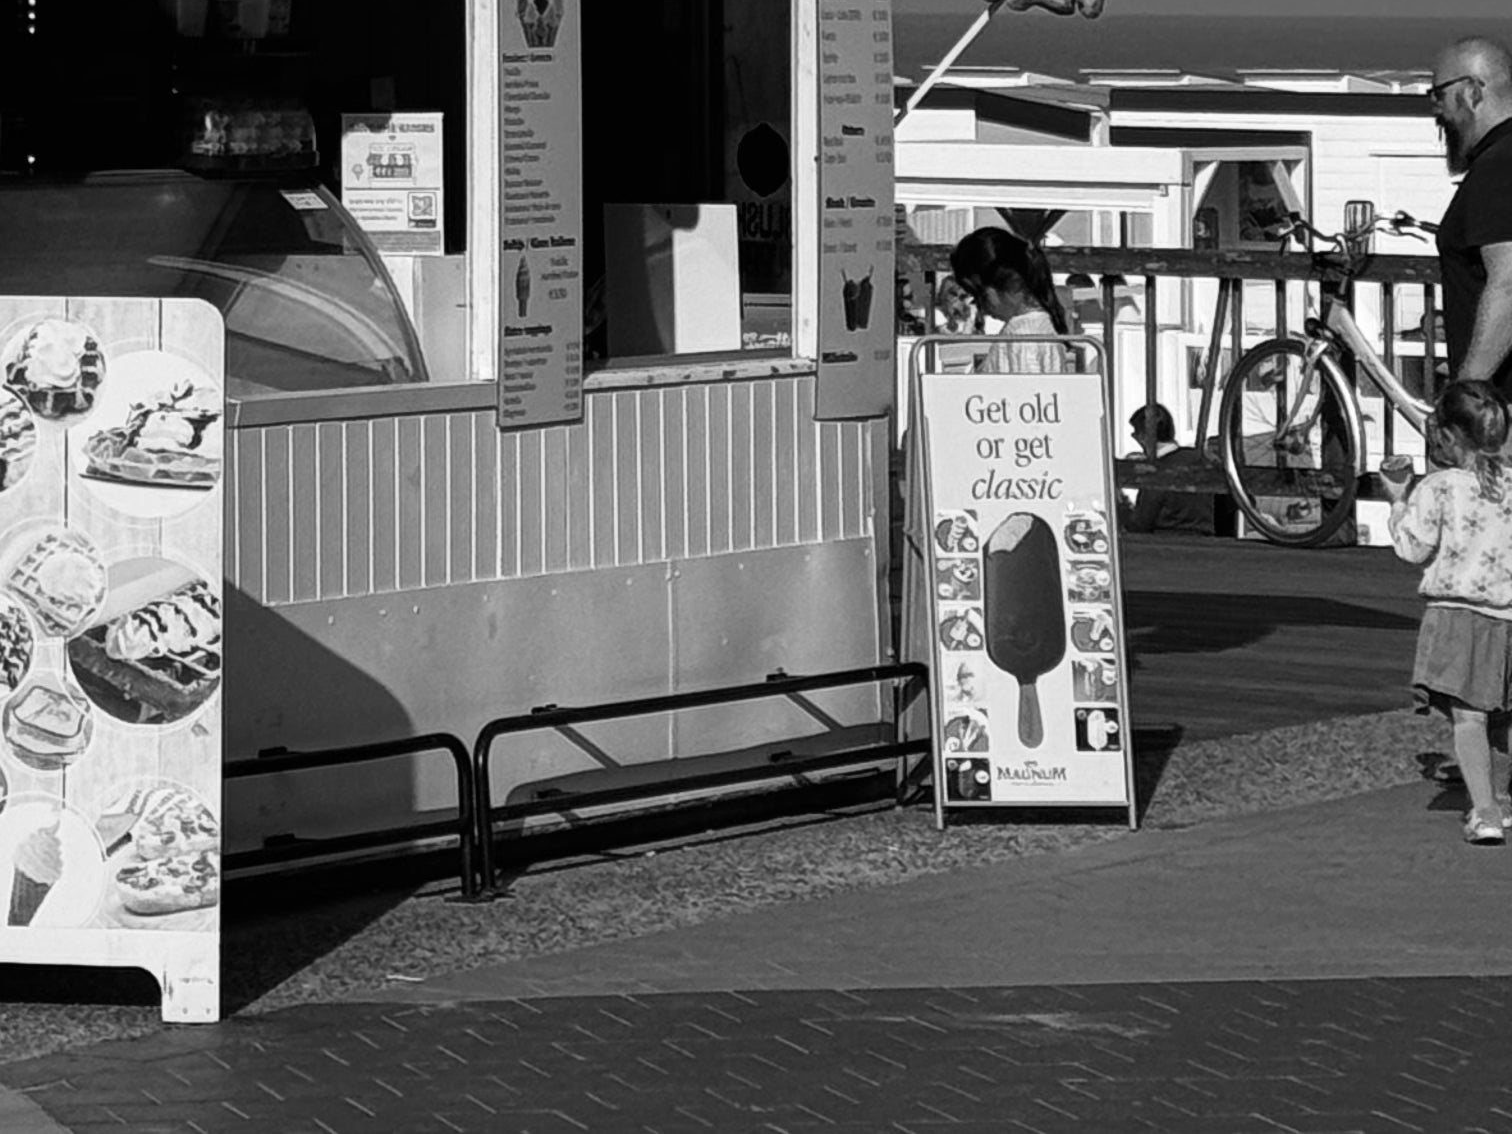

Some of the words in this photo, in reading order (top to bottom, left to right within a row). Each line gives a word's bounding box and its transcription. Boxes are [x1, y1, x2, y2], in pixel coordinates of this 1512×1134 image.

[964, 394, 1011, 424] Get
[1019, 392, 1061, 424] old
[976, 439, 1005, 460] or
[1014, 434, 1054, 468] get
[971, 469, 1064, 501] classic
